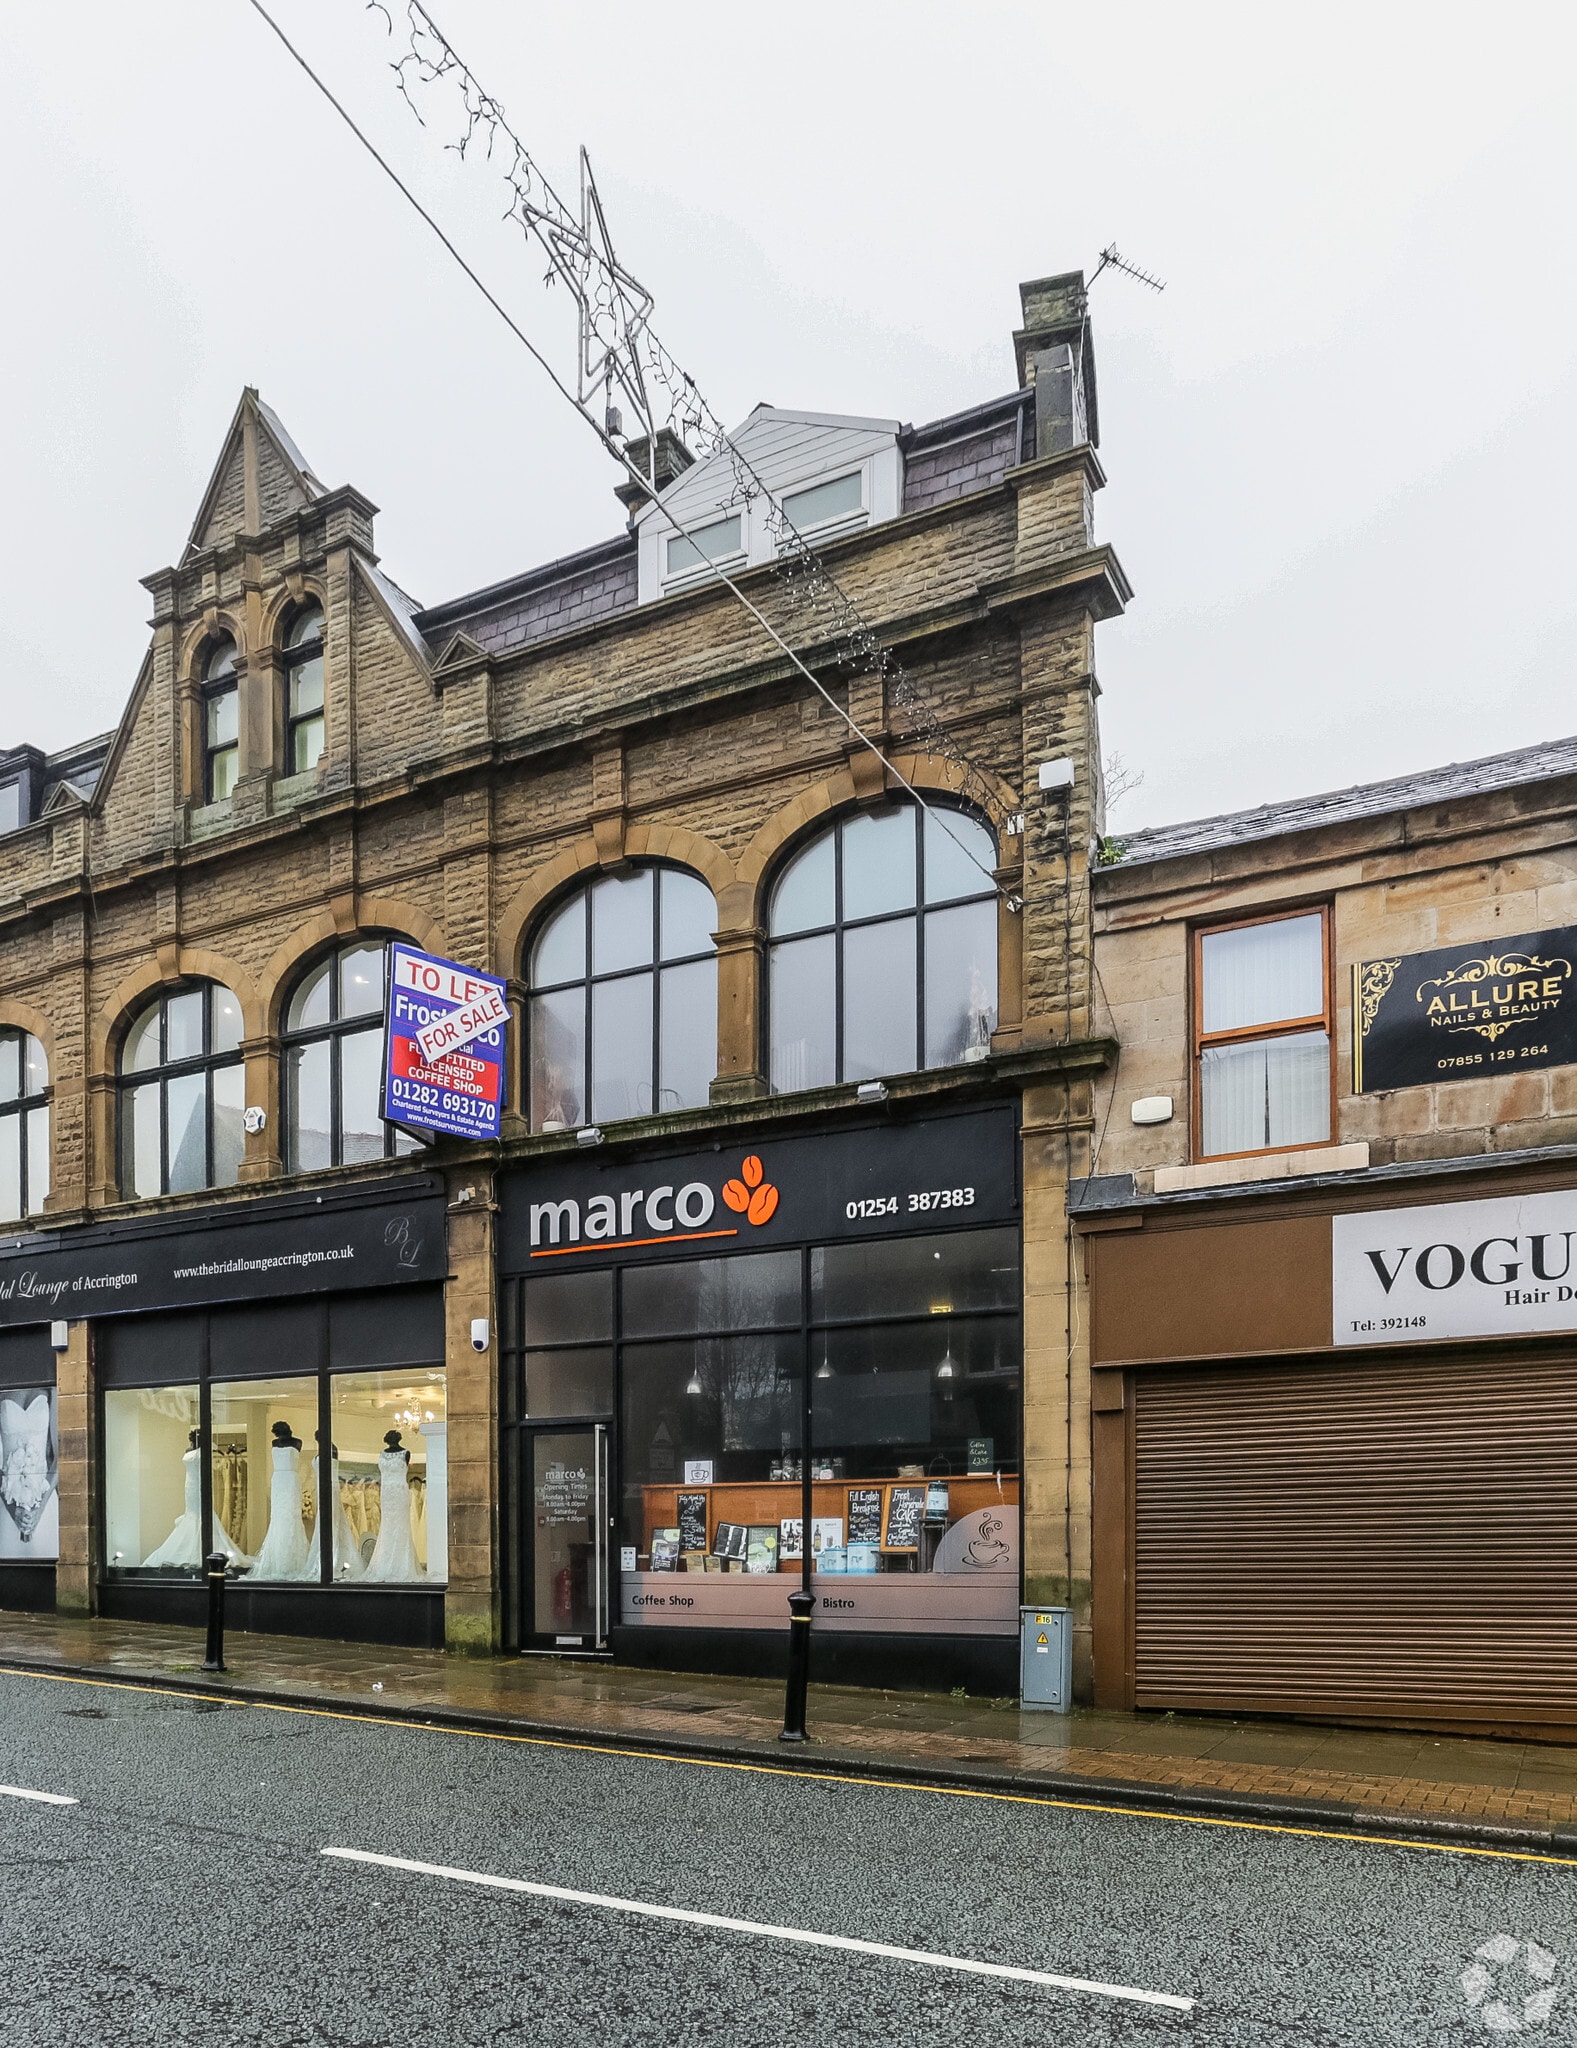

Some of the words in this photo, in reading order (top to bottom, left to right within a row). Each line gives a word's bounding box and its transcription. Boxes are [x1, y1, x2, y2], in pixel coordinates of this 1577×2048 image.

[406, 960, 440, 991] TO
[1425, 975, 1563, 1016] ALLURE
[422, 1022, 460, 1054] FOR
[460, 997, 504, 1033] SALE
[1431, 1012, 1476, 1027] NAILS
[1481, 1008, 1493, 1019] &
[1499, 999, 1560, 1017] BEAUTY
[446, 1053, 485, 1072] FITTED
[1437, 1053, 1483, 1069] 07855
[1490, 1049, 1516, 1062] 129
[1520, 1044, 1549, 1058] 264
[408, 1066, 451, 1087] COFFEE
[453, 1079, 483, 1095] SHOP
[392, 1079, 439, 1106] 01282
[443, 1093, 496, 1120] 693170
[392, 1099, 422, 1112] Chartered
[422, 1106, 450, 1120] Surveyors
[457, 1116, 474, 1126] Estate
[475, 1120, 495, 1131] Agents
[407, 1112, 481, 1137] www.frostsurveyors.com
[530, 1182, 715, 1246] marco
[846, 1196, 899, 1219] 01254
[908, 1187, 975, 1212] 387383
[173, 1244, 355, 1279] www.thebridalloungeaccrington.co.uk
[1363, 1231, 1577, 1295] VOGU
[17, 1271, 69, 1305] Lounge
[72, 1276, 83, 1291] of
[84, 1273, 138, 1290] Accrington
[1503, 1286, 1550, 1307] Hair
[1350, 1320, 1376, 1332] Tel:
[1380, 1315, 1427, 1330] 392148
[543, 1484, 569, 1492] Opening
[545, 1471, 576, 1480] marco
[572, 1493, 589, 1501] Friday
[849, 1491, 859, 1501] Full
[860, 1490, 880, 1503] English
[896, 1509, 918, 1523] CAKE
[632, 1595, 666, 1606] Coffee
[669, 1595, 694, 1608] Shop
[822, 1598, 855, 1609] Bistro
